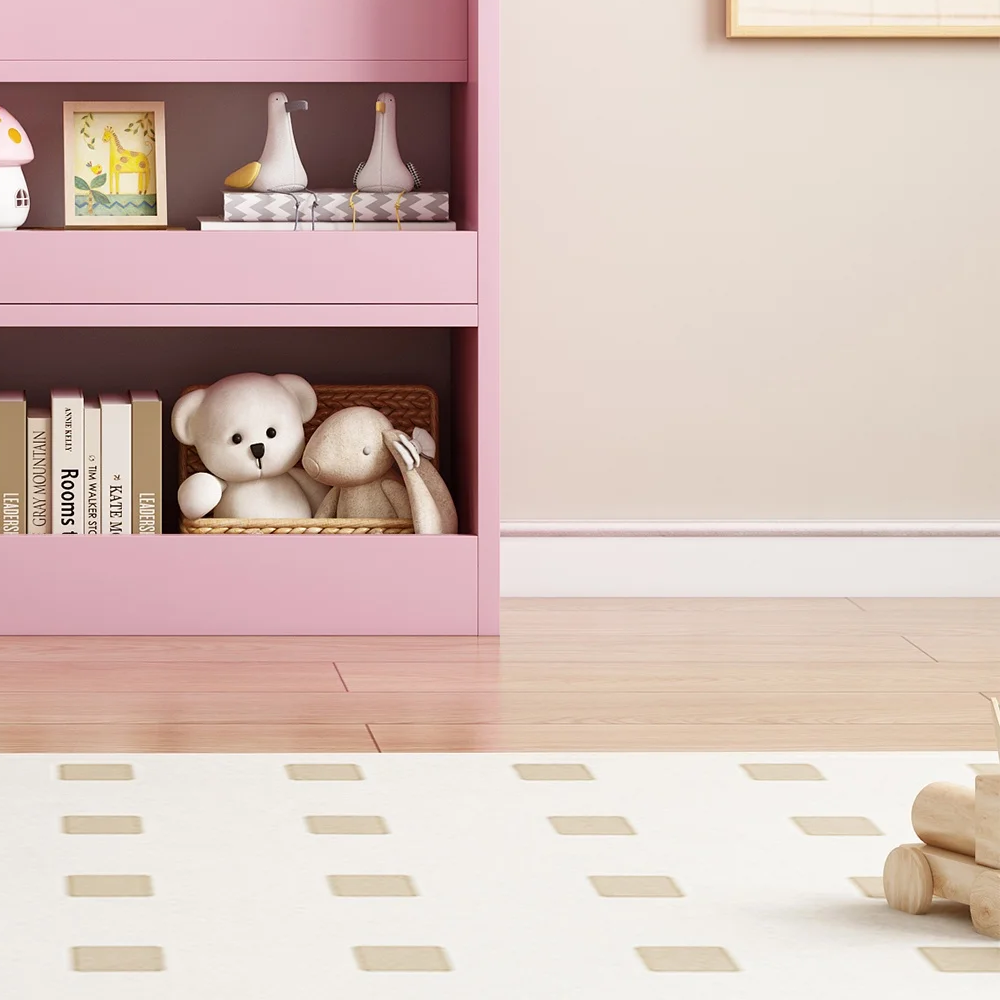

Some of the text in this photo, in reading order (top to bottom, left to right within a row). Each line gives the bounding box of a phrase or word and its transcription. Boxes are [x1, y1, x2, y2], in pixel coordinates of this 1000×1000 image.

[33, 431, 46, 527] GRAY MOUNTAIN
[88, 466, 97, 480] TIM
[3, 493, 19, 534] LEADERS
[61, 469, 79, 526] Rooms
[88, 483, 97, 518] WALKER
[110, 485, 122, 534] KATE M
[139, 493, 155, 534] LEADERS
